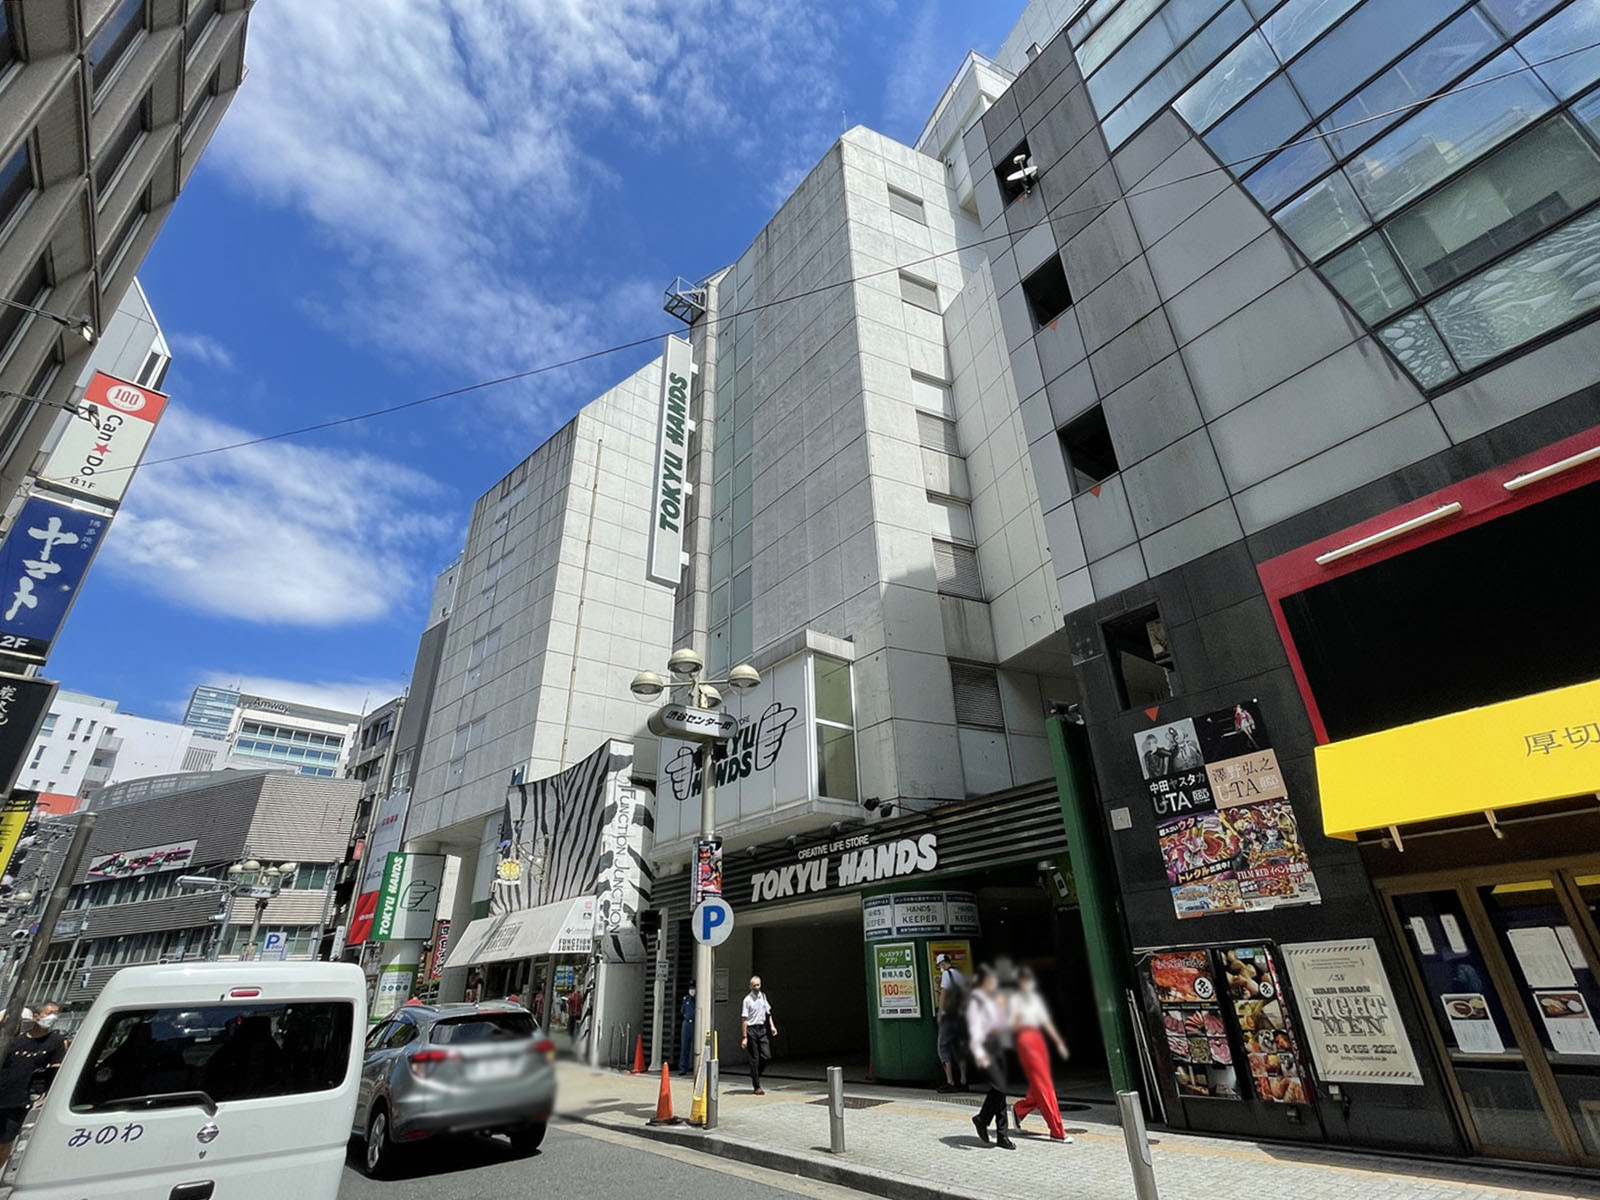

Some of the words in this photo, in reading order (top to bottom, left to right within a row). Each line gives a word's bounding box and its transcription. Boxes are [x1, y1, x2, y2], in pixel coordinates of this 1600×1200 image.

[114, 388, 140, 406] 100
[666, 372, 688, 447] HANDS
[70, 477, 97, 489] B1F
[659, 449, 683, 533] TOKYU
[5, 516, 79, 621] ヤマト
[0, 635, 30, 649] 2F
[252, 697, 291, 713] Amway
[691, 751, 753, 797] HNDS
[1149, 772, 1206, 795] 中田ヤスタカ
[797, 845, 828, 860] CREATIVE
[829, 840, 845, 853] LIFE
[845, 834, 870, 848] STORE
[387, 855, 405, 895] HANDS
[750, 857, 829, 903] TOKYU
[837, 833, 938, 887] HANDS
[379, 897, 396, 935] TOKYU
[902, 915, 938, 924] KEEPER
[906, 904, 932, 912] HANDS
[702, 905, 726, 940] P
[266, 934, 280, 949] P
[883, 983, 899, 996] 100
[1304, 995, 1389, 1020] EIGHT
[1320, 1018, 1387, 1037] MEN
[67, 1122, 144, 1148] みのわ
